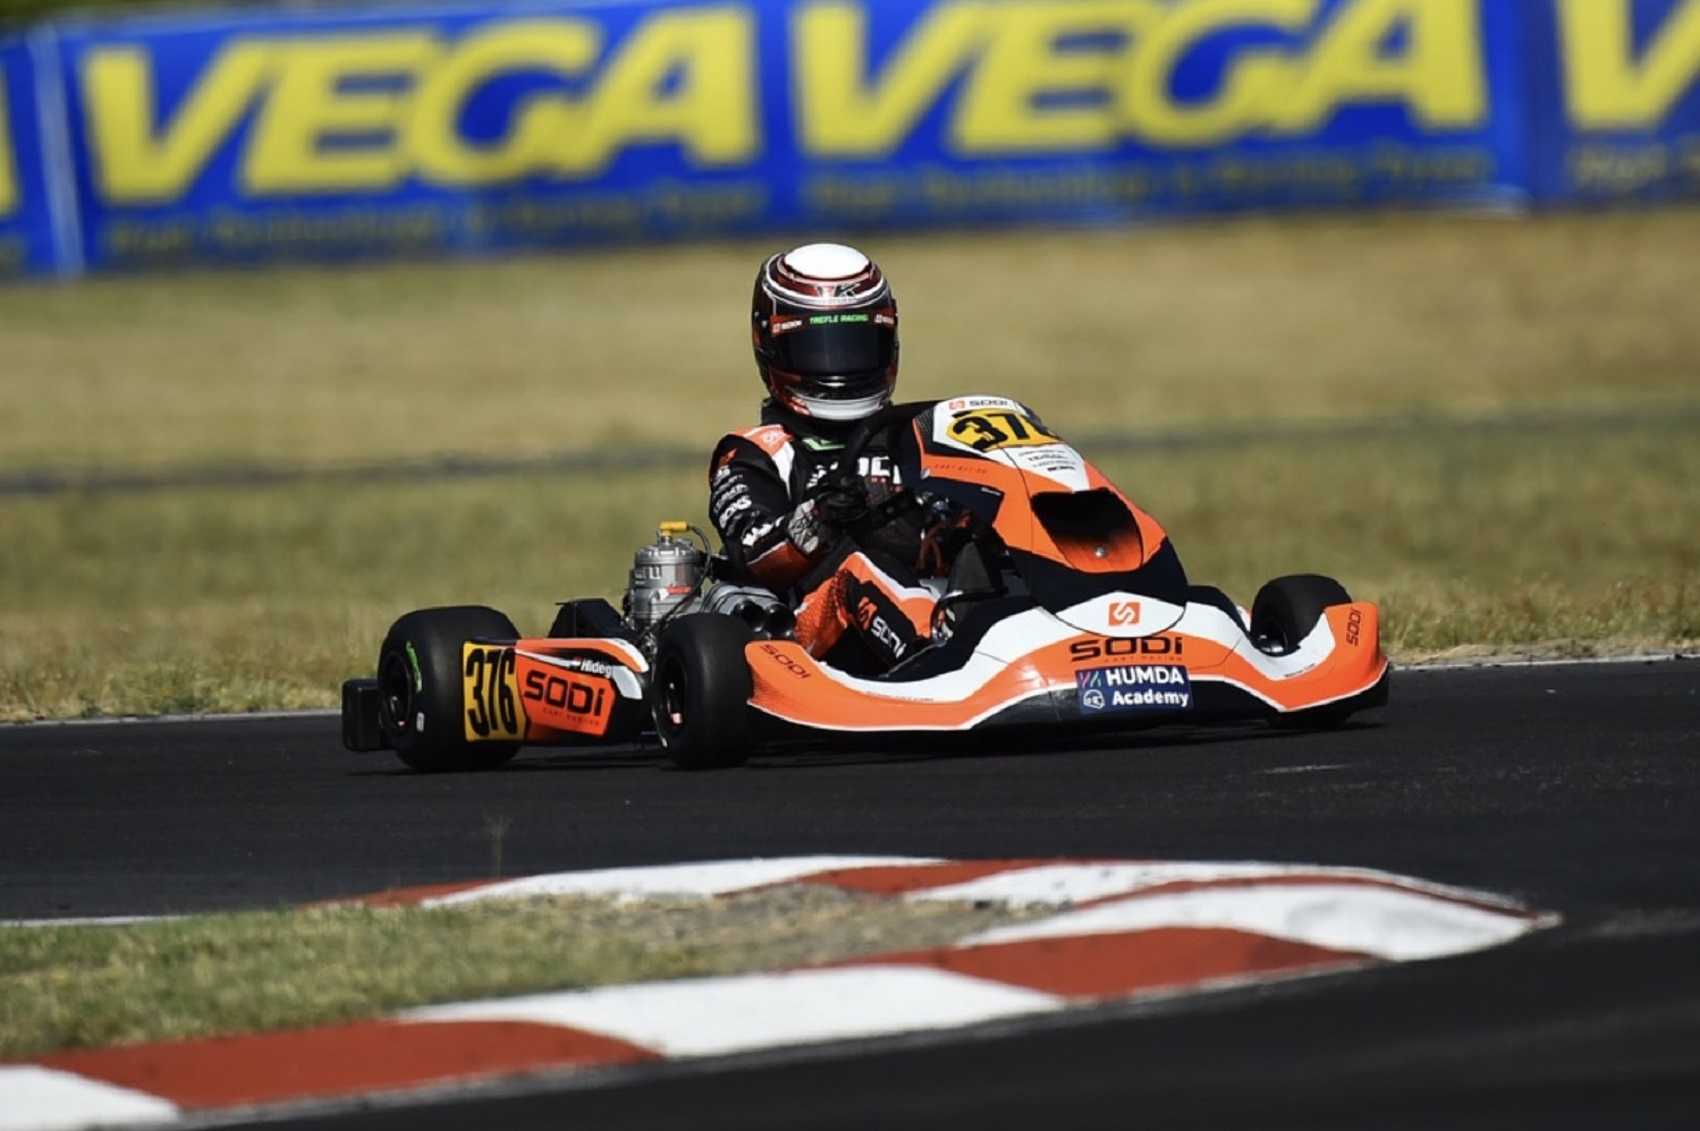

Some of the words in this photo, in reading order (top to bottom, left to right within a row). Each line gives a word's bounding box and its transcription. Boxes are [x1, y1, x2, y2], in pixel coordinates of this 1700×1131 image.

[80, 3, 760, 201] VEGA
[792, 0, 1488, 156] VEGA
[466, 647, 518, 738] 376
[1105, 666, 1185, 687] HUMDA
[1112, 688, 1189, 708] Academy
